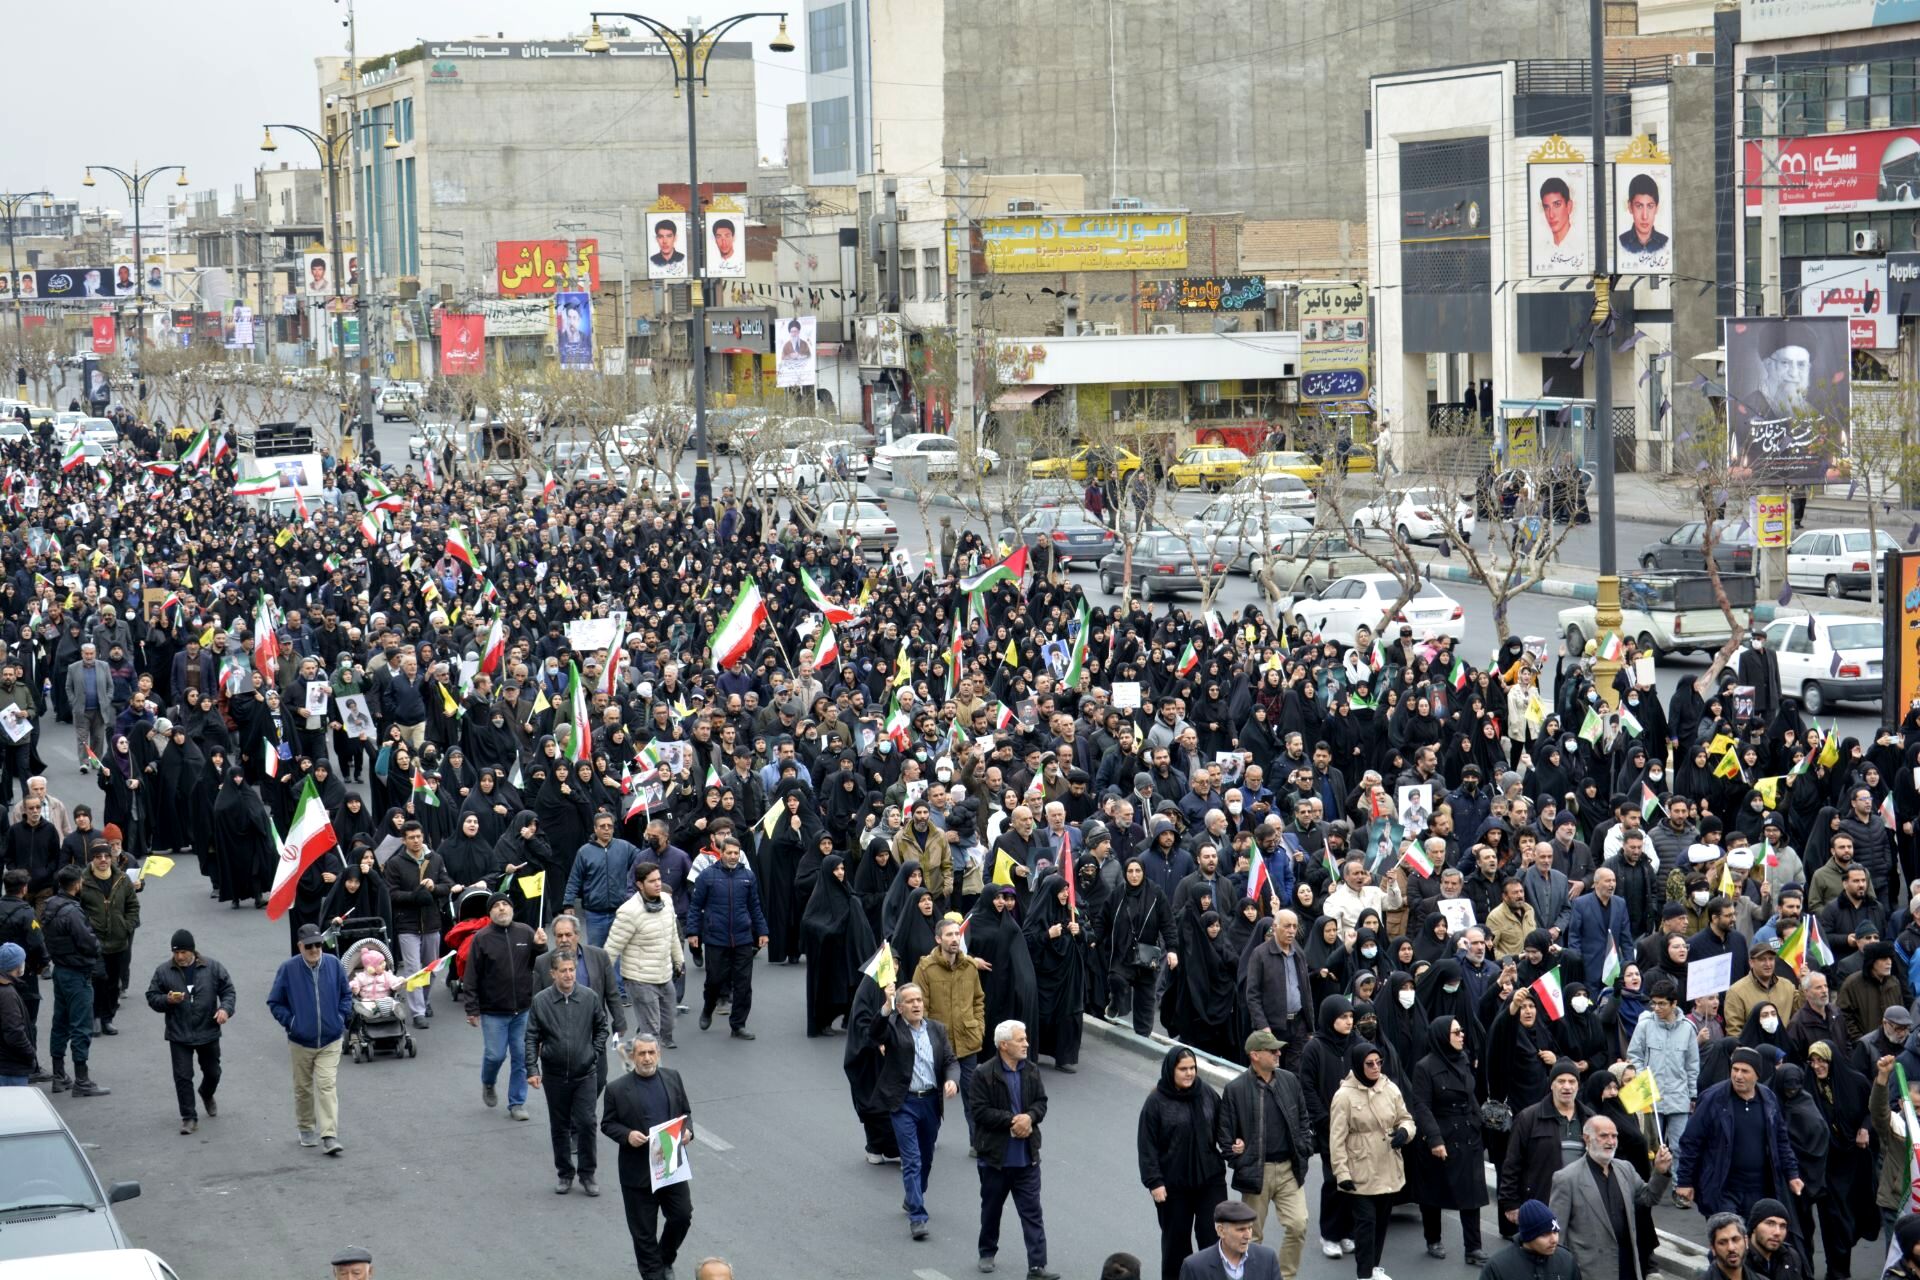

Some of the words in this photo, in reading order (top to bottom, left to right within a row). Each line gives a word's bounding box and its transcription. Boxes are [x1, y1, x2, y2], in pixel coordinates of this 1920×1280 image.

[431, 44, 510, 58] موراکو
[1813, 146, 1857, 176] تسکو
[502, 244, 594, 289] کرواش
[1889, 263, 1918, 282] Apple
[1335, 289, 1364, 314] قهوه
[1817, 278, 1880, 313] ولیعصر
